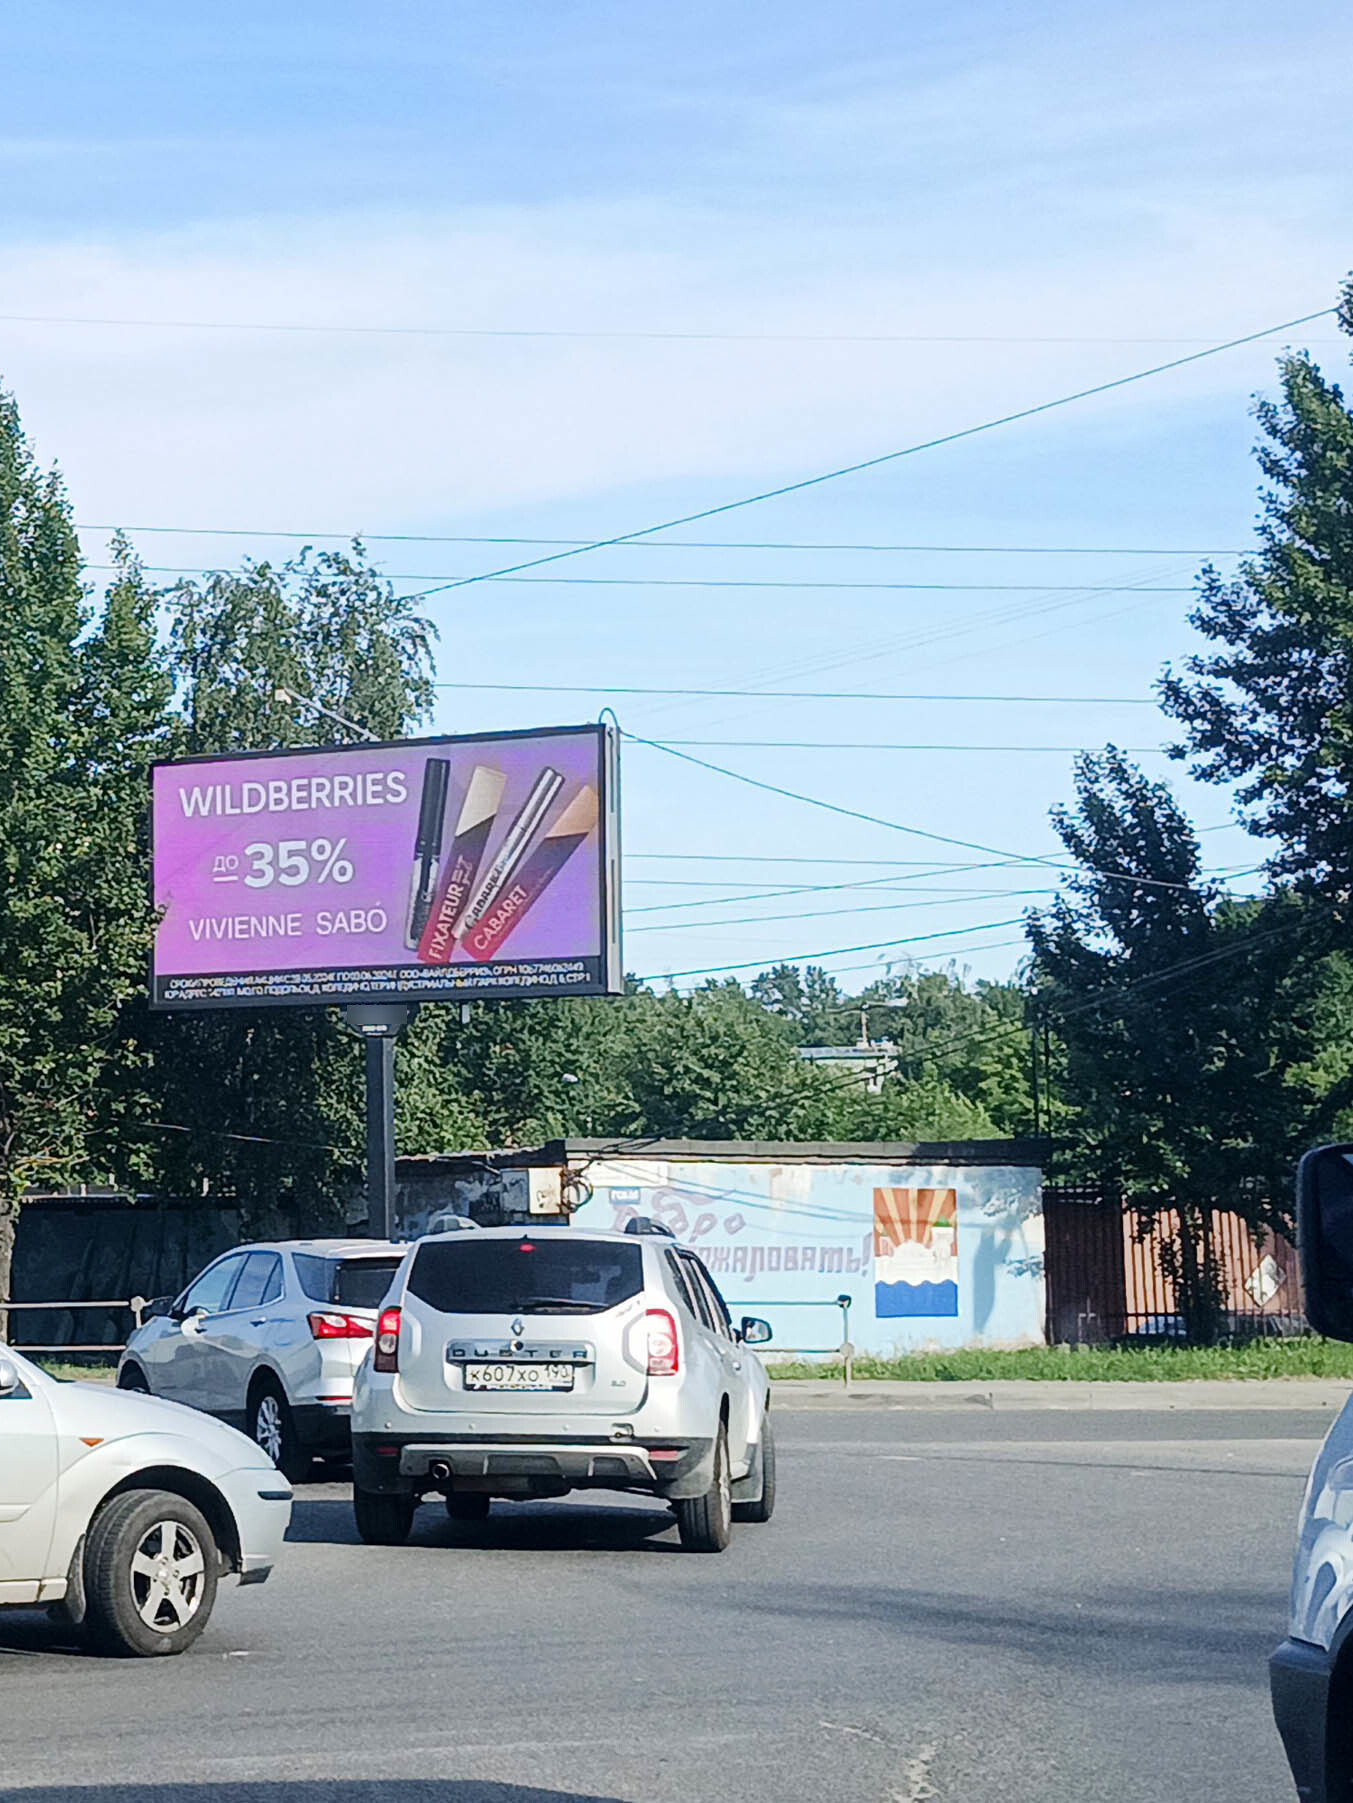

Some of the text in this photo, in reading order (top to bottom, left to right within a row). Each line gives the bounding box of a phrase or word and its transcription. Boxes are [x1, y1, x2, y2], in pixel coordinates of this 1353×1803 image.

[178, 771, 408, 818] WILDBERRIES
[243, 837, 354, 888] 35%
[188, 913, 304, 941] VIVIENNE
[428, 881, 465, 960] FIXATEUR
[474, 884, 528, 951] CABARET
